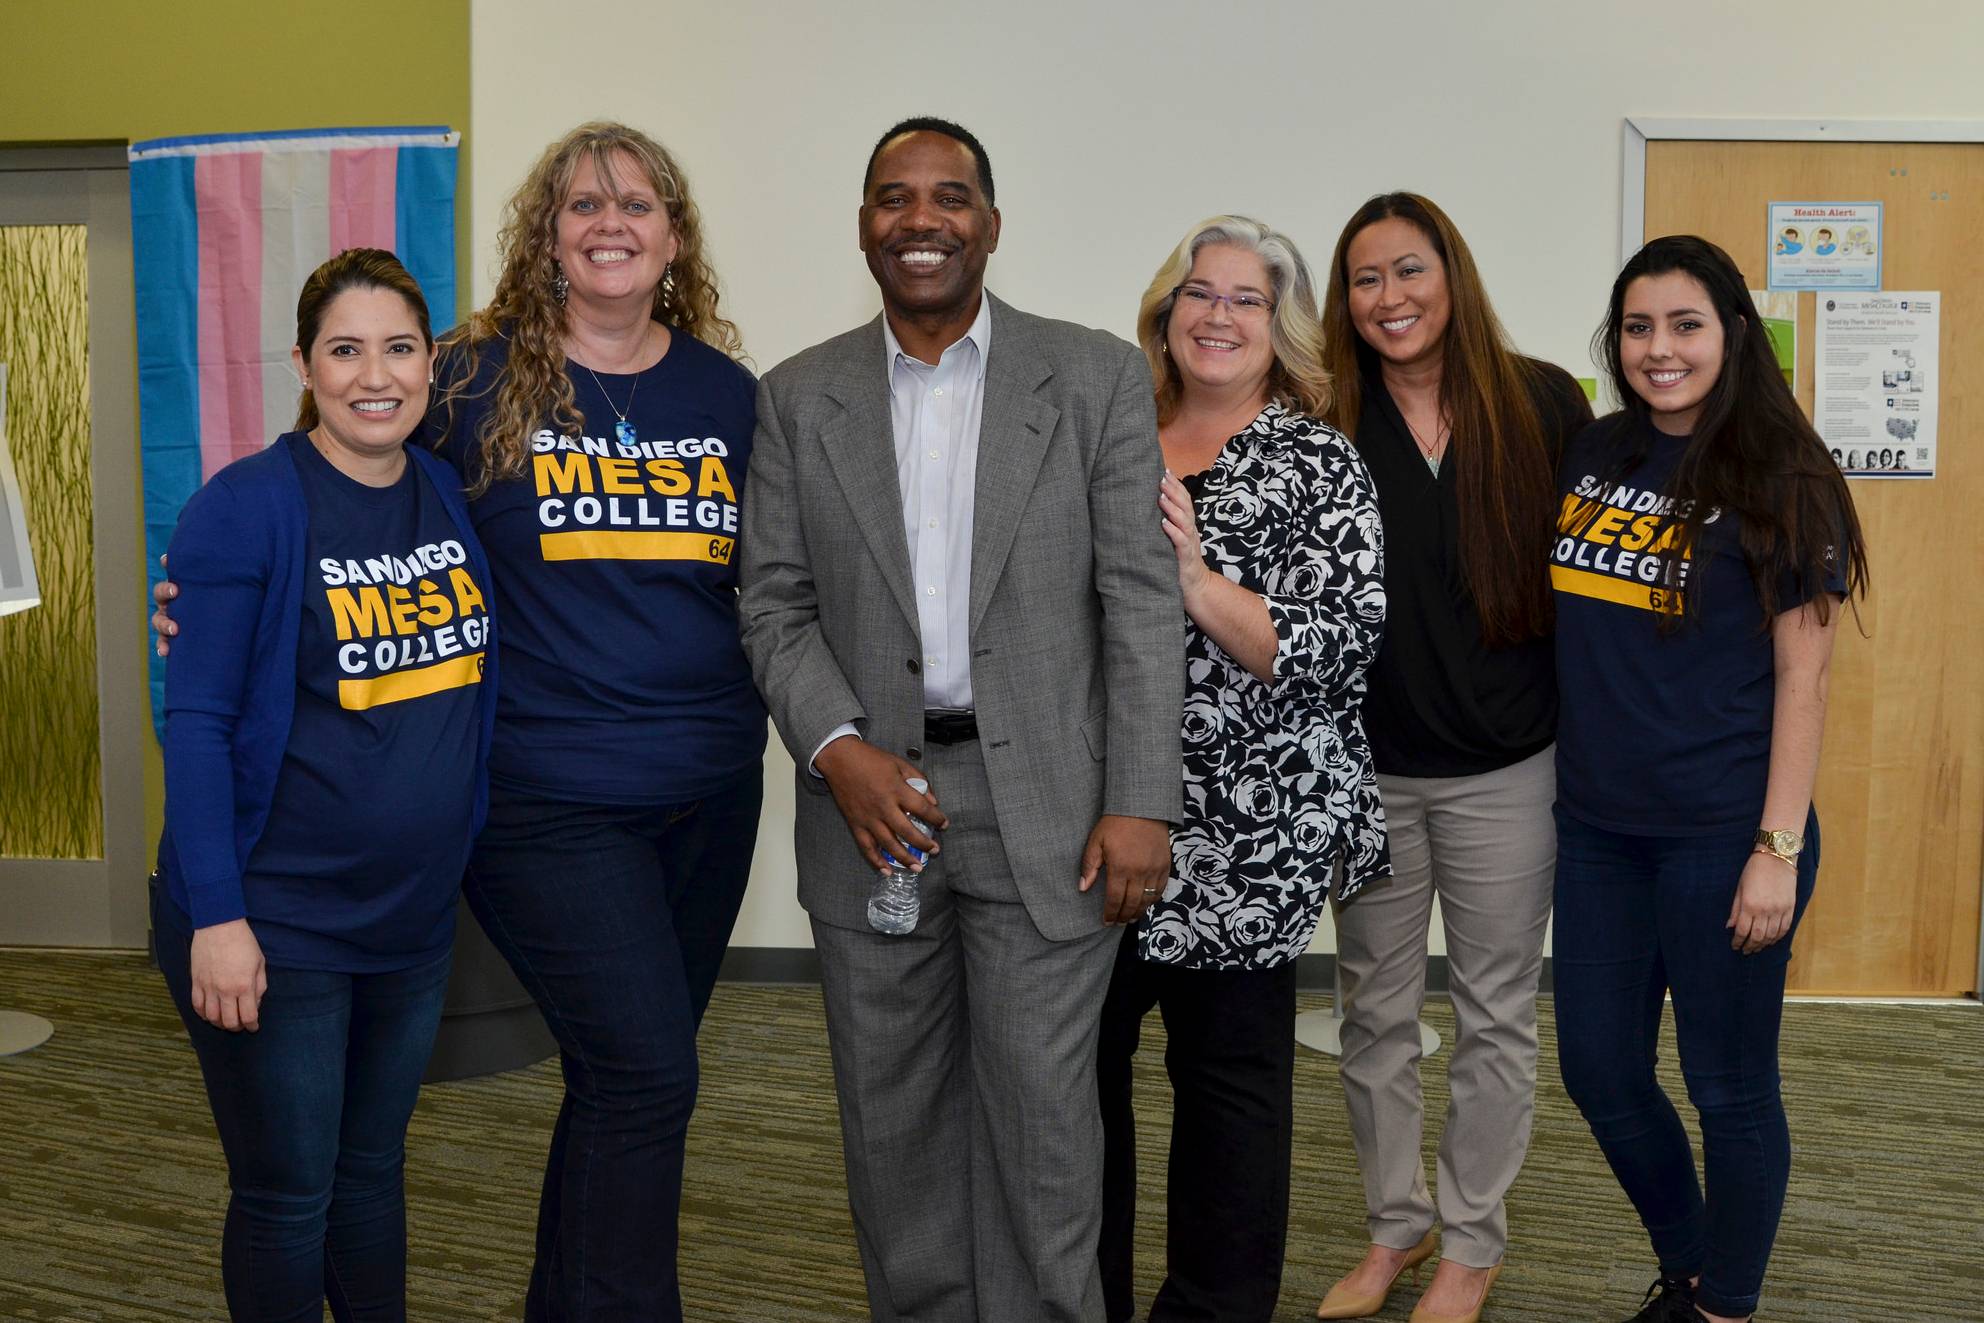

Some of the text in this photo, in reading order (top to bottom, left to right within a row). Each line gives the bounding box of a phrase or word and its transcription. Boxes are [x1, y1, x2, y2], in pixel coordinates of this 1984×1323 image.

[533, 452, 737, 503] MESA
[538, 496, 738, 533] COLLEGE
[708, 538, 730, 561] 64
[1550, 536, 1690, 587] OLLEGE
[326, 567, 487, 641] MESA
